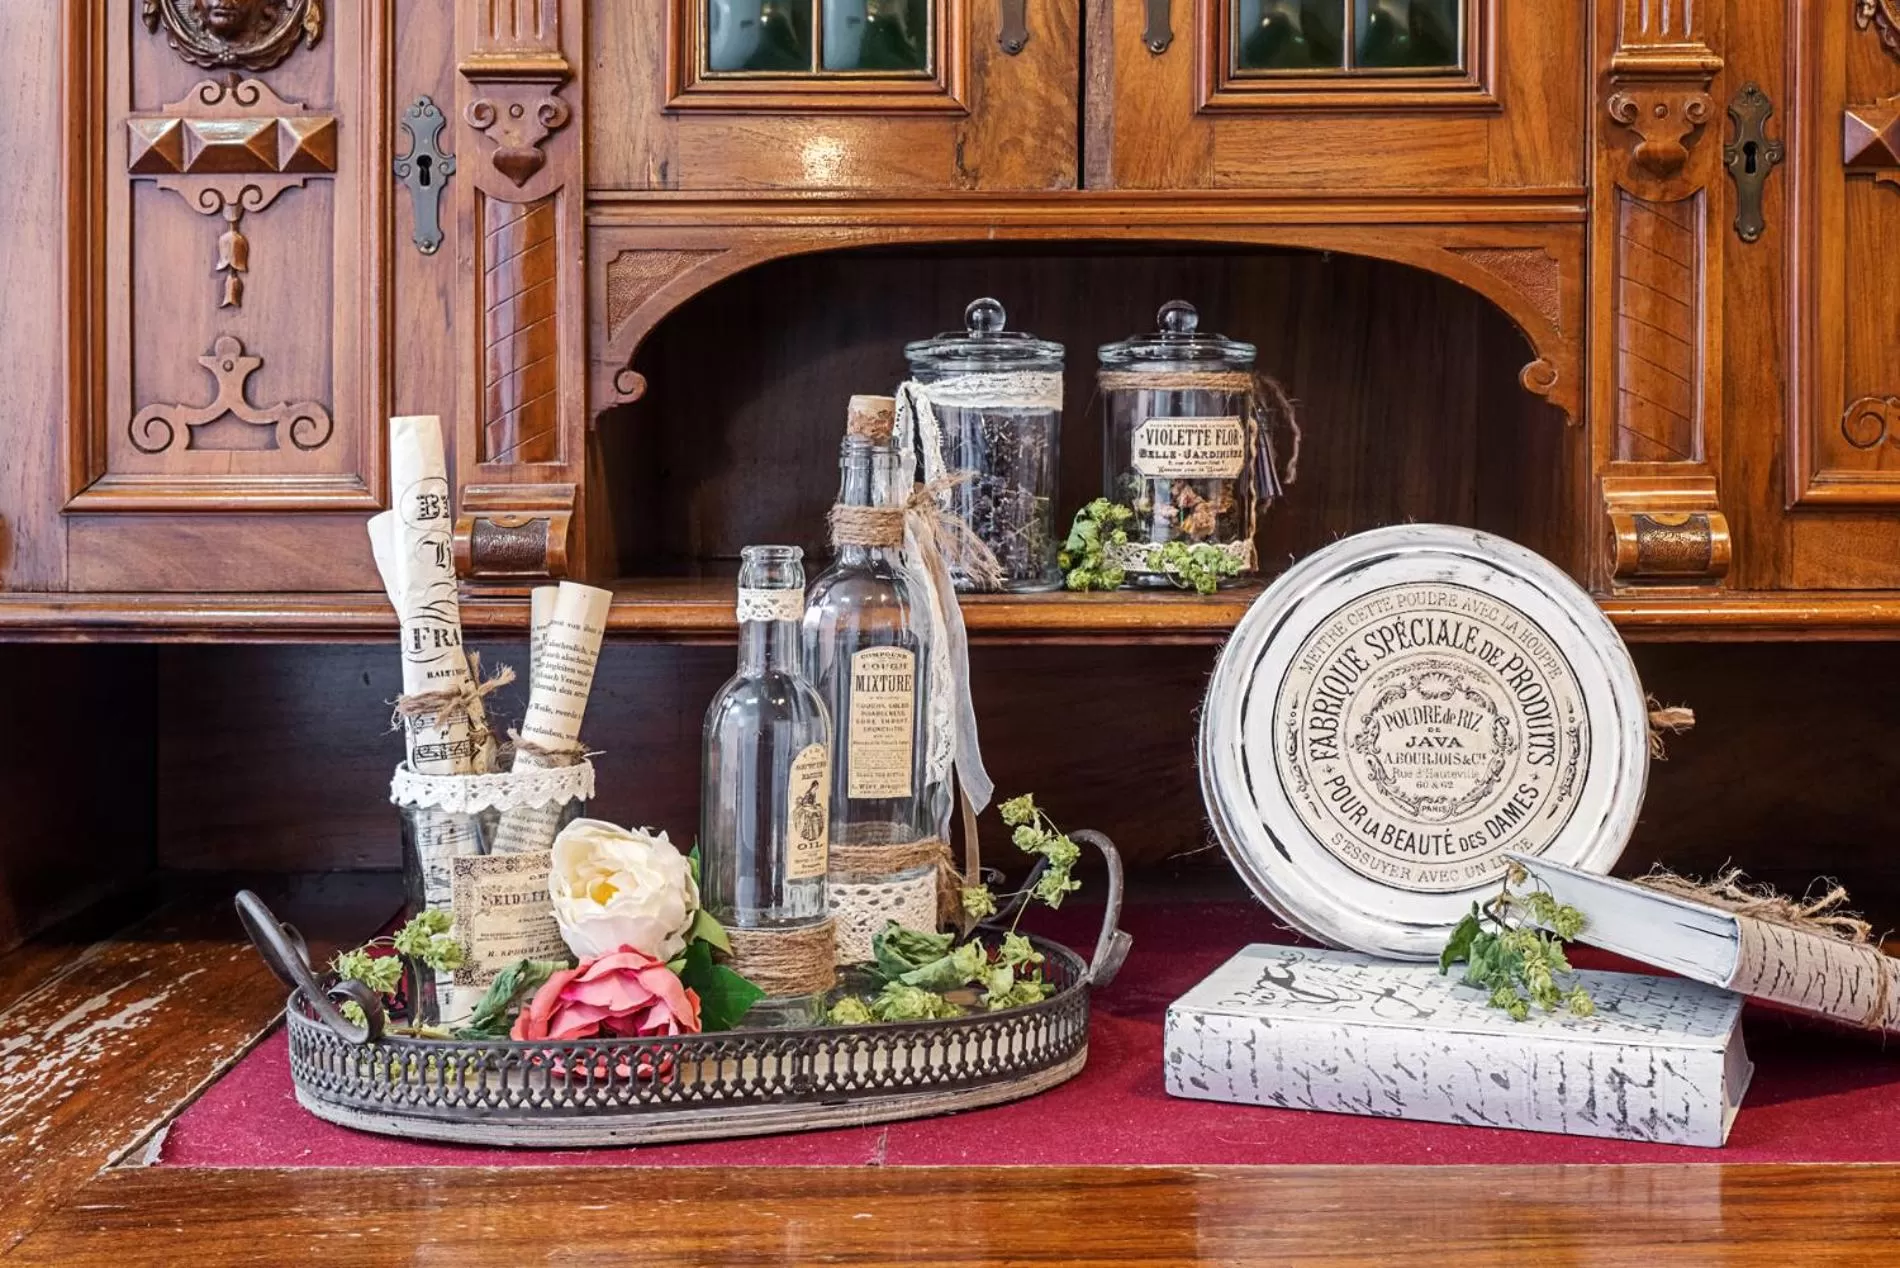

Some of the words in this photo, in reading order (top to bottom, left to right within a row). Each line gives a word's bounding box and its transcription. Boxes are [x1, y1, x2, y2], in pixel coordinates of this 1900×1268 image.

[1146, 428, 1211, 446] VIOLETTE
[1216, 428, 1240, 446] FLOR
[1299, 622, 1349, 675] METTRE
[1346, 596, 1394, 627] CETTE
[1396, 591, 1458, 608] POUDRE
[1461, 597, 1500, 621] AVEC
[1500, 615, 1518, 635] LA
[1518, 627, 1563, 680] HOUPPE
[855, 674, 912, 692] MIXTURE
[1308, 645, 1371, 762] FABRIQUE
[1363, 616, 1480, 661] SPÉCIALE
[1478, 639, 1505, 668] DE
[1499, 652, 1556, 767] PRODUITS
[1381, 705, 1442, 732] POUDRE
[1457, 709, 1484, 733] RIZ
[1405, 736, 1464, 748] JAVA
[1323, 775, 1368, 826] POUR
[1362, 817, 1378, 839] LA
[1380, 828, 1456, 856] BEAUTÉ
[1459, 830, 1487, 851] DES
[1484, 783, 1539, 840] DAMES
[797, 842, 823, 850] OIL
[1331, 832, 1412, 882] S'ESSUYER
[1417, 868, 1460, 884] AVEC
[1465, 862, 1487, 878] UN
